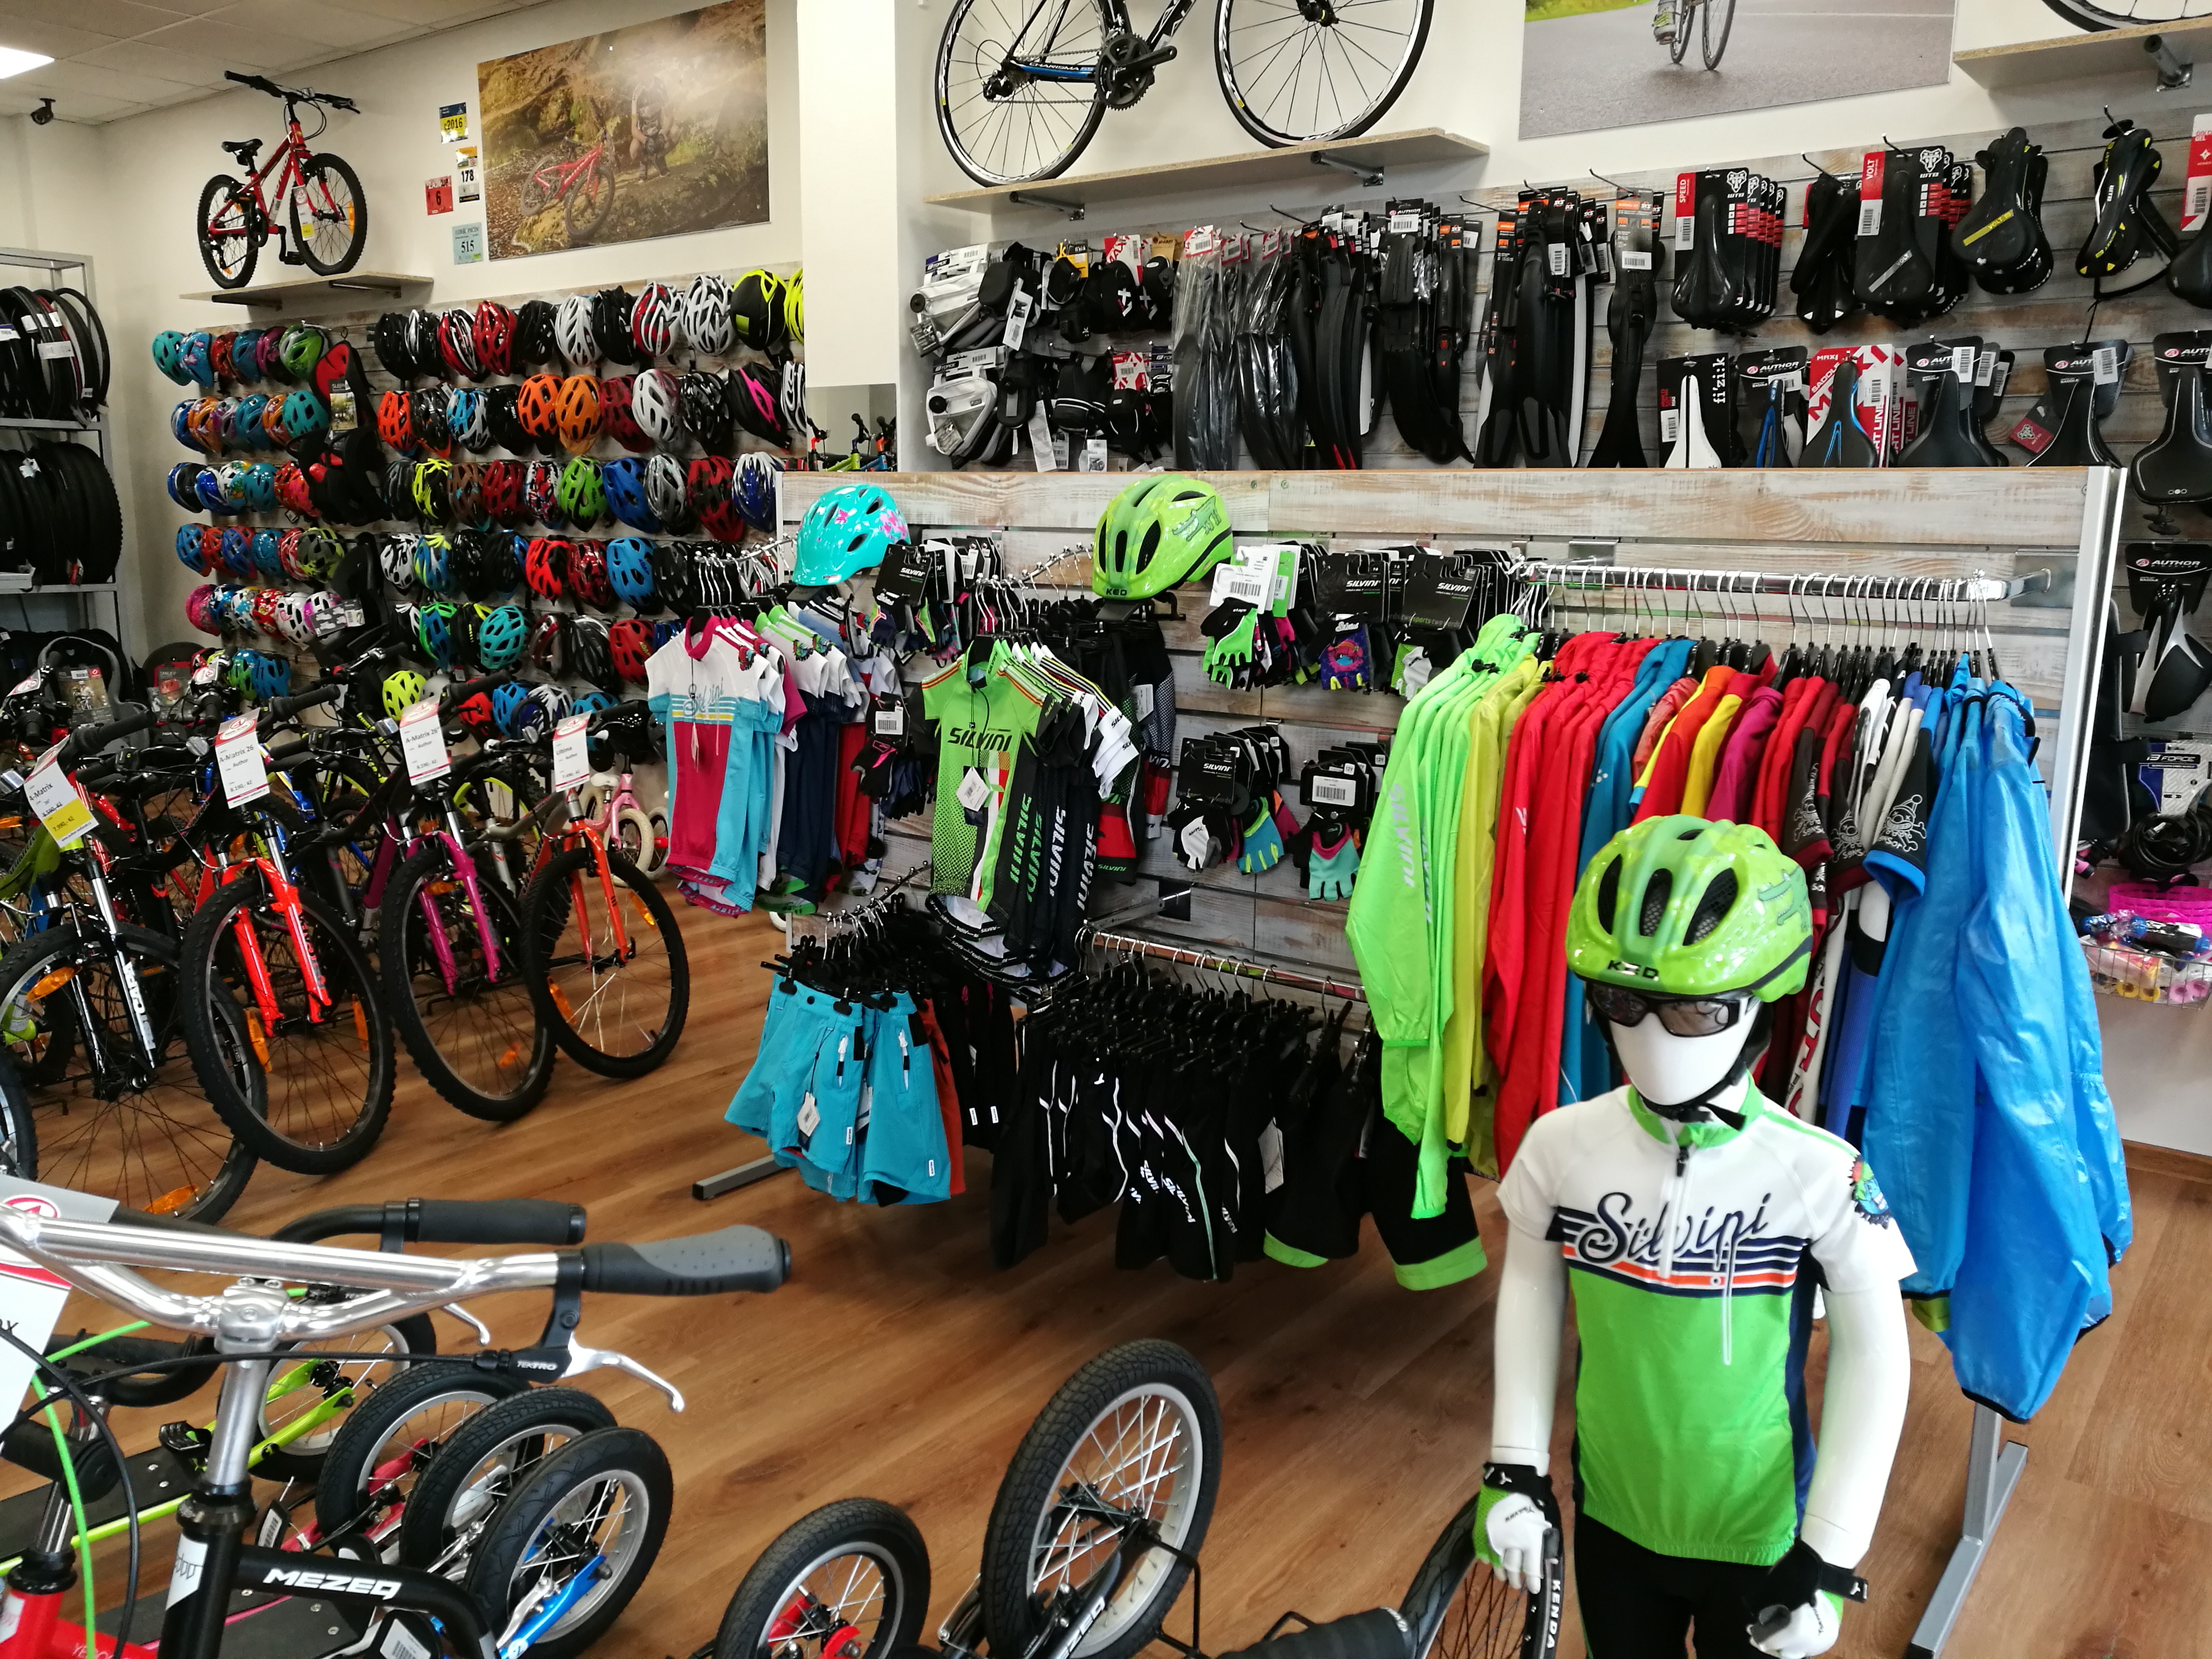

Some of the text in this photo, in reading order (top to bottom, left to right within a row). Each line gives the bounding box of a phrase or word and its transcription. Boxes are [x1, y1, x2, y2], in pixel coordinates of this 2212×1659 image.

[1029, 62, 1079, 71] CHARISMA
[461, 169, 474, 182] 178
[1866, 159, 1875, 180] VOLT
[436, 190, 442, 205] 6
[1988, 216, 2003, 229] VOLT
[461, 240, 474, 253] 515
[1895, 253, 1910, 266] VOLT
[1760, 361, 1799, 371] AUTHOR
[1812, 362, 1841, 394] SADDLE
[1105, 588, 1127, 596] KED
[1437, 582, 1471, 593] SILVINI
[988, 651, 998, 675] SILVINI
[406, 732, 429, 744] A-Matrix
[948, 727, 1012, 751] SILVINI
[1203, 763, 1231, 772] SILVINI
[1388, 783, 1415, 887] SILVINI
[1026, 811, 1042, 903] SILVINI
[1049, 806, 1066, 898] SILVINI
[1098, 864, 1127, 872] SILVINI
[1578, 1192, 1772, 1268] Silvini
[517, 1360, 557, 1371] TEKTRO
[263, 1568, 404, 1601] MEZEQ
[1546, 1579, 1561, 1649] KENDA
